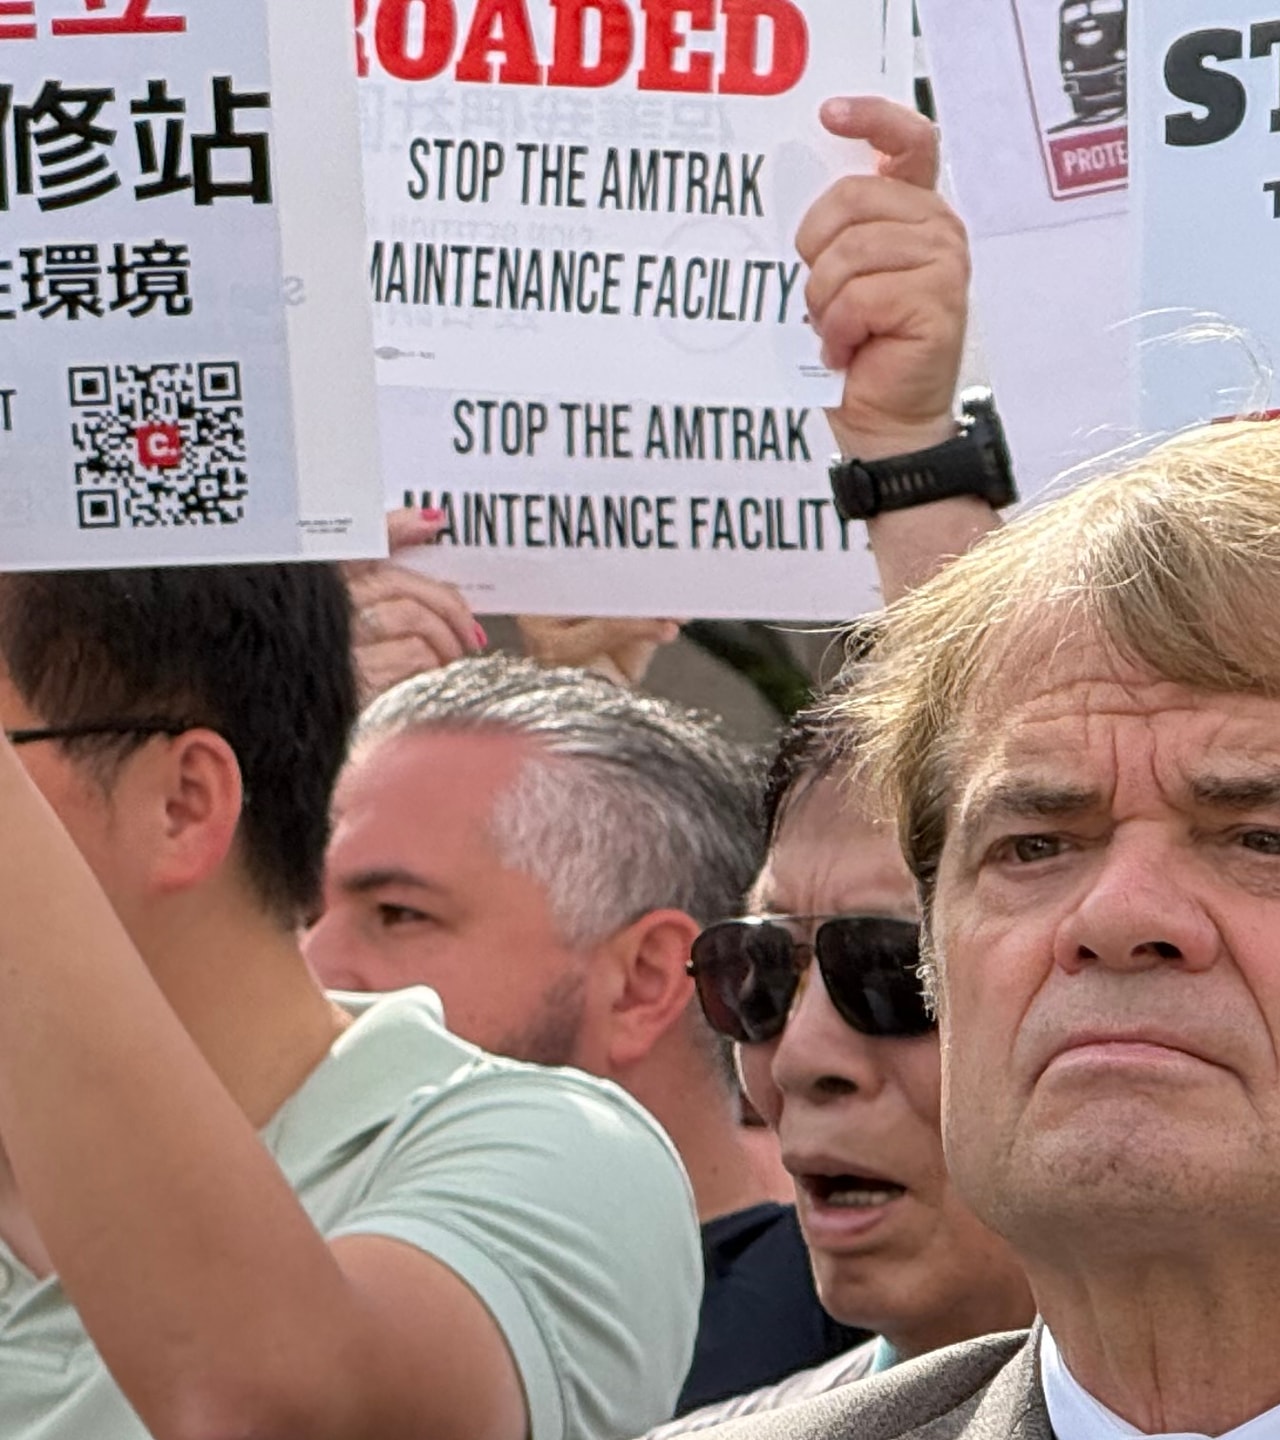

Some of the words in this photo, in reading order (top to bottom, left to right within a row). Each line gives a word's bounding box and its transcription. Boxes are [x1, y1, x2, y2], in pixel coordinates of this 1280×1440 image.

[354, 0, 811, 96] OADED
[407, 138, 504, 204] STOP
[517, 143, 588, 208] THE
[598, 147, 766, 217] AMTRAK
[0, 239, 193, 320] 環境
[634, 256, 810, 325] FACILITY
[453, 398, 547, 456] STOP
[560, 402, 632, 459] THE
[644, 404, 812, 462] AMTRAK
